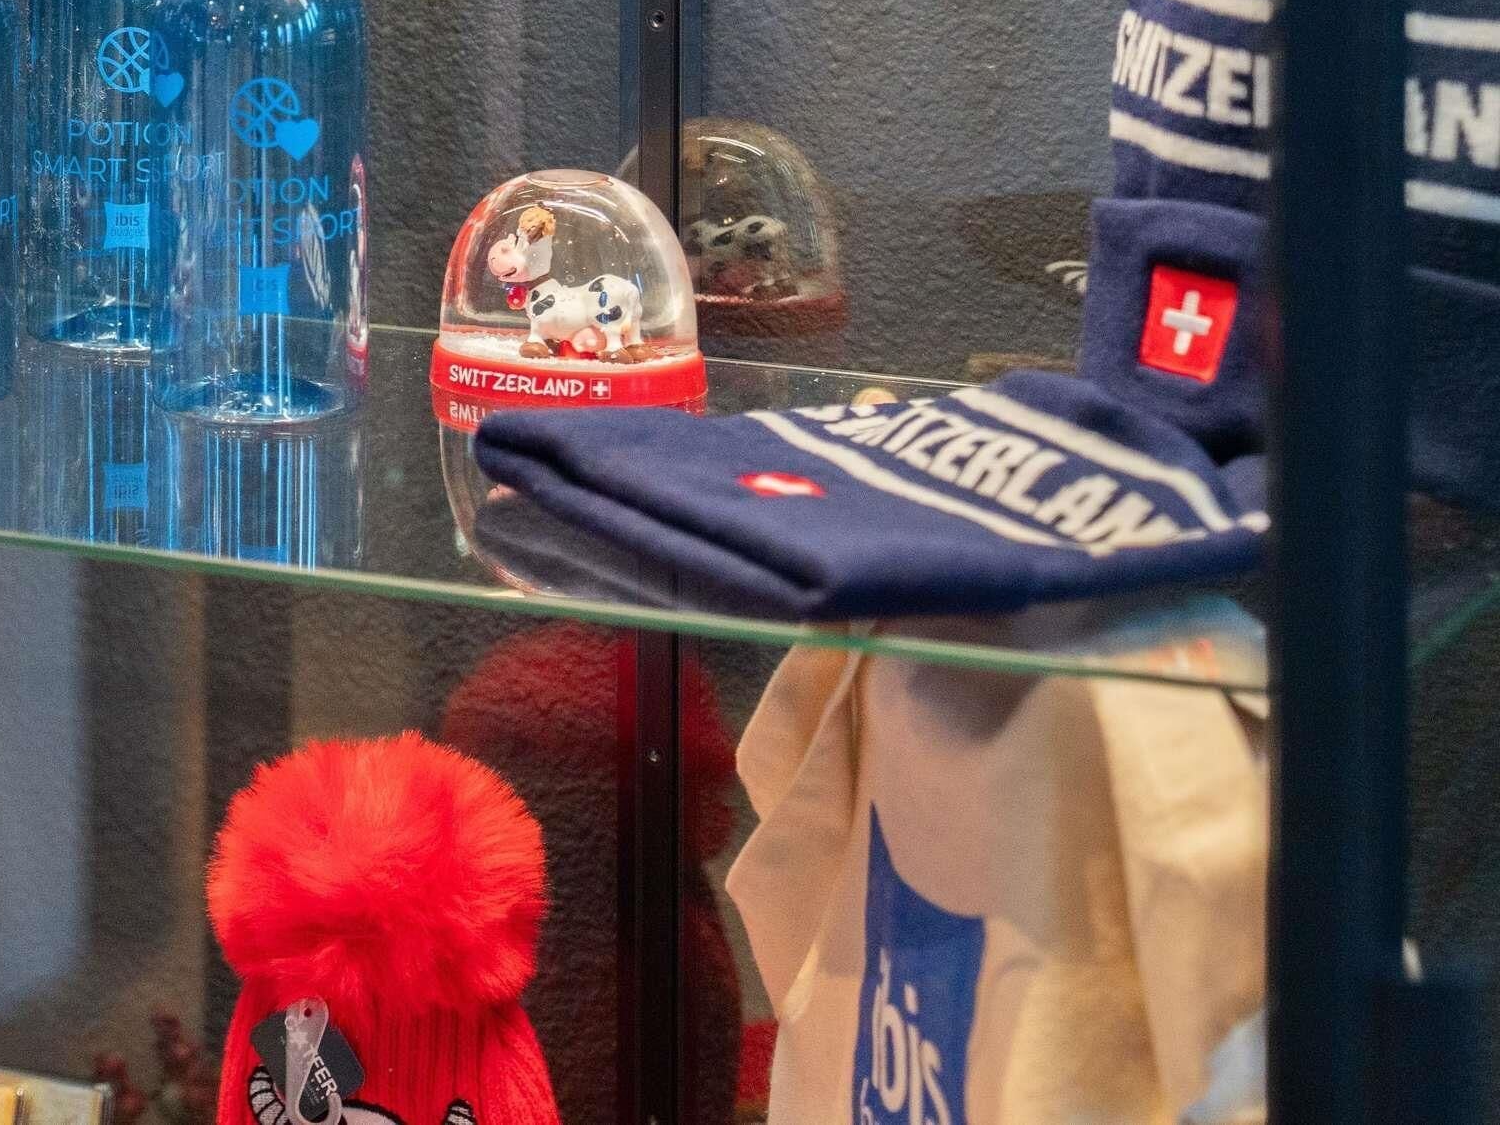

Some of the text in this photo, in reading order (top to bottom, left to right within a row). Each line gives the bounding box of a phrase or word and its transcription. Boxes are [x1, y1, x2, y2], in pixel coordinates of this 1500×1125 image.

[68, 119, 193, 147] POTION
[33, 150, 127, 182] SMART
[115, 212, 140, 226] ibis
[449, 364, 585, 397] SWITZERLAND
